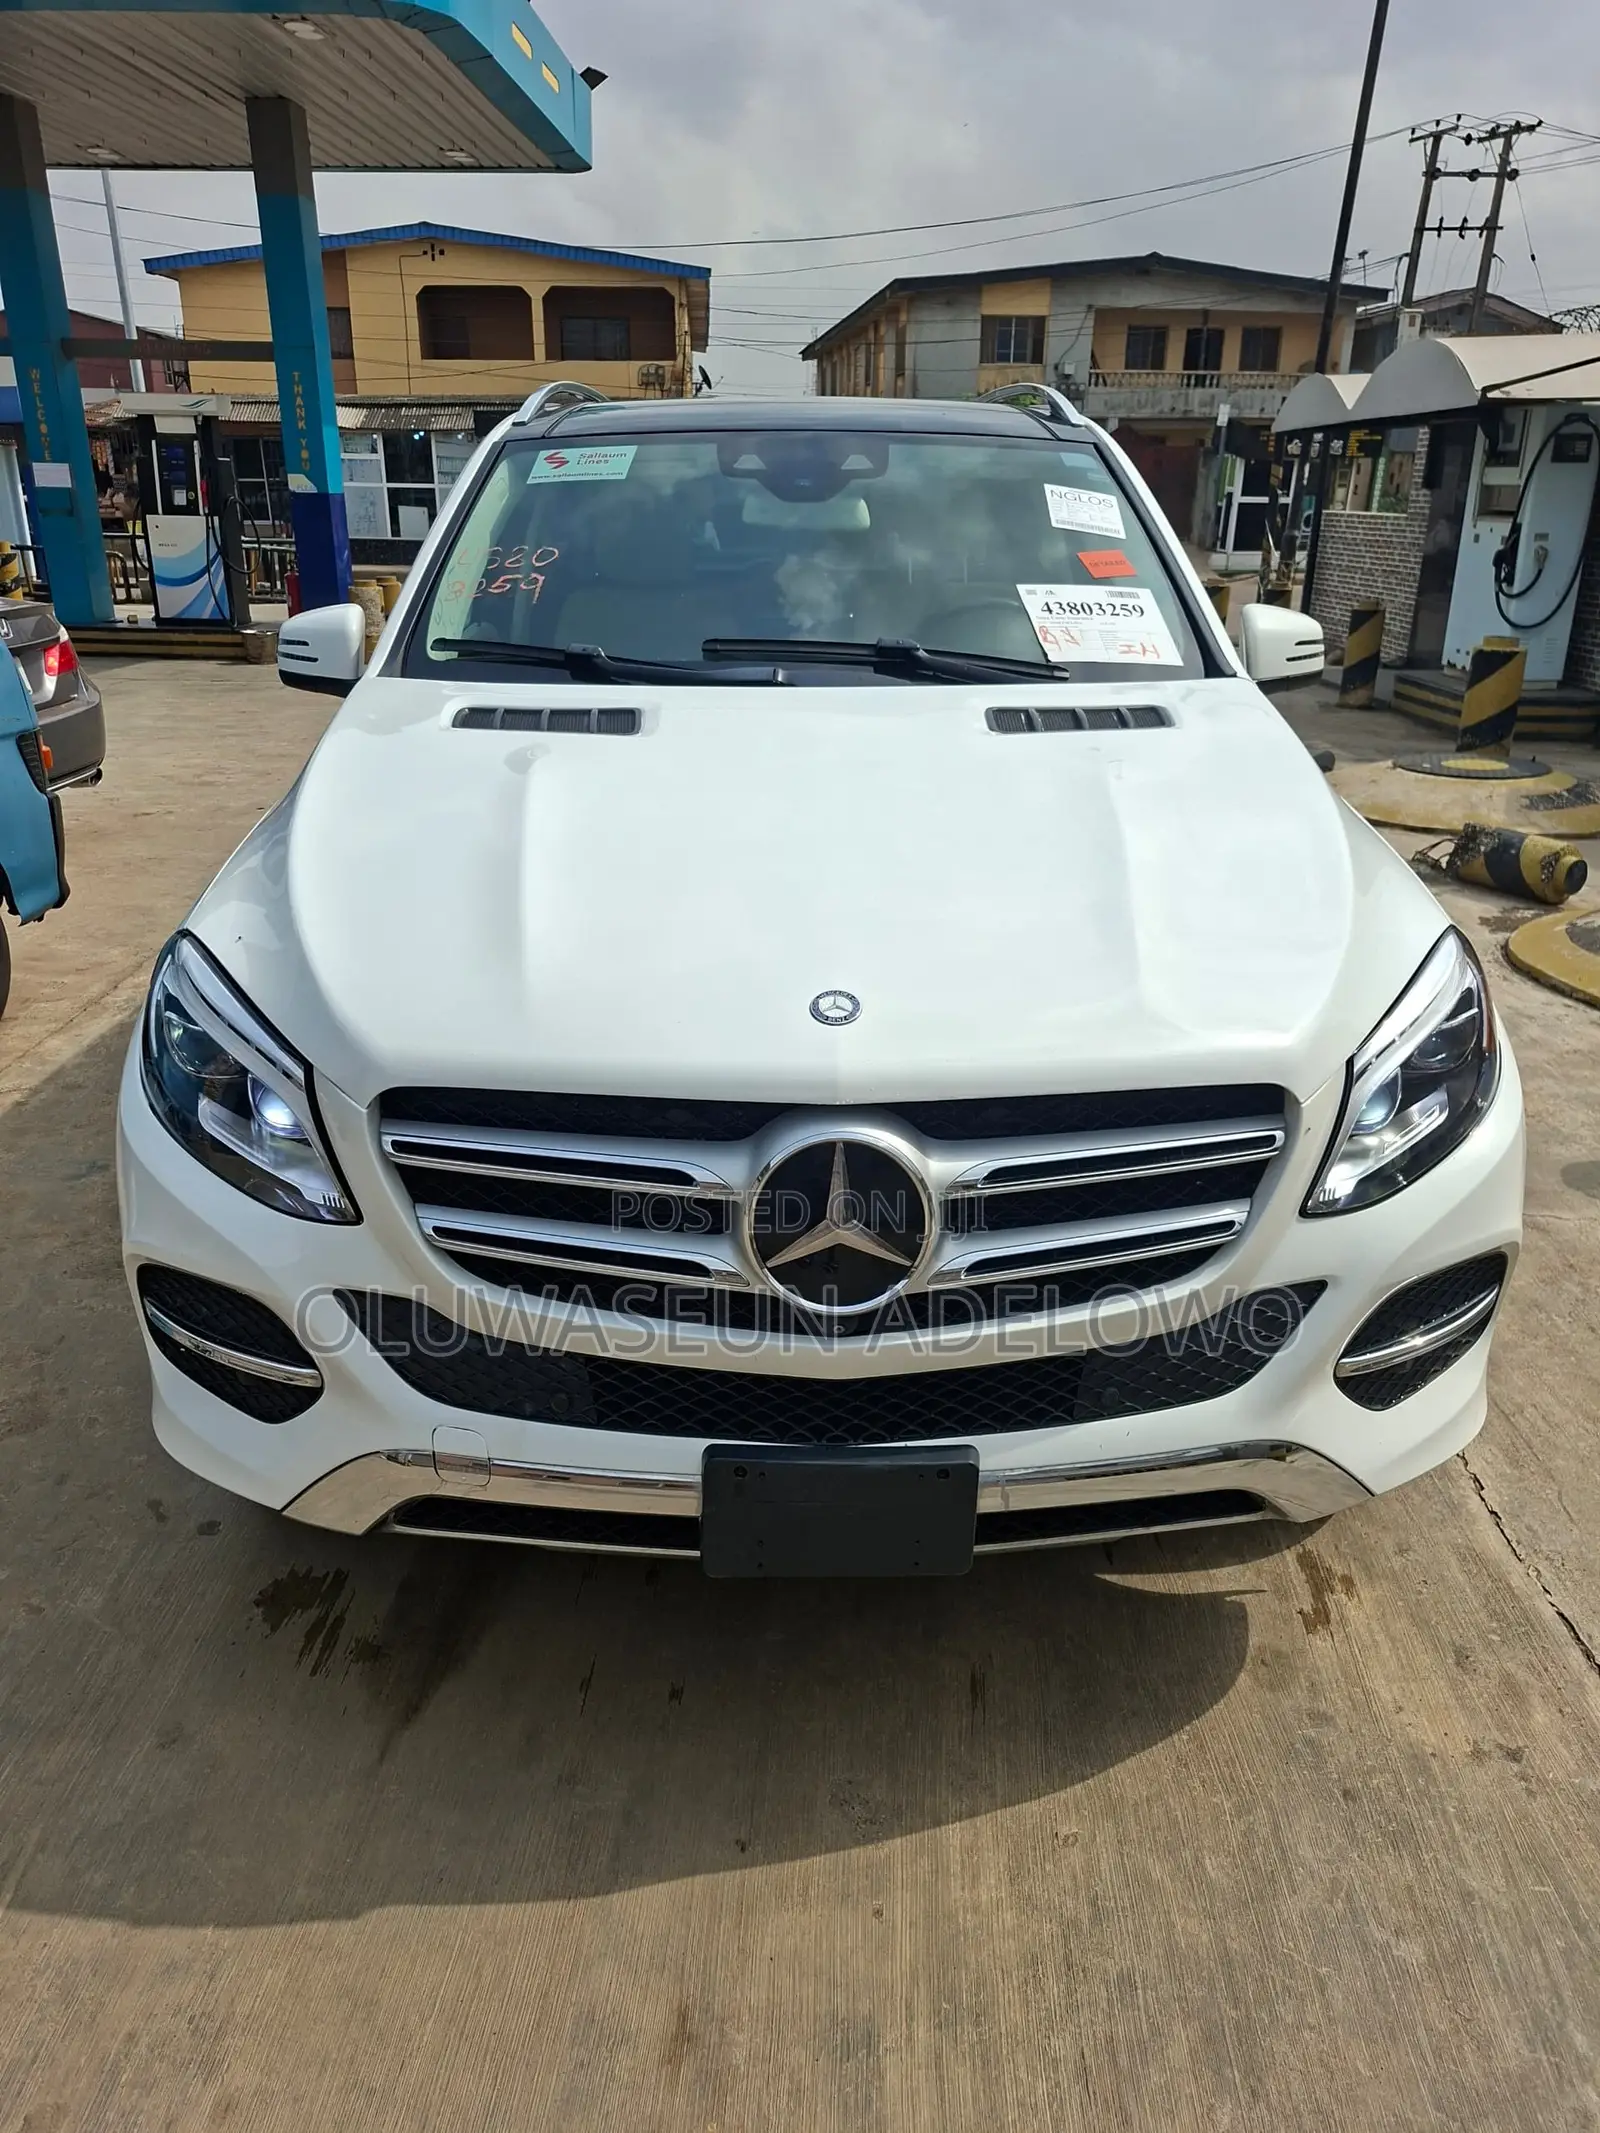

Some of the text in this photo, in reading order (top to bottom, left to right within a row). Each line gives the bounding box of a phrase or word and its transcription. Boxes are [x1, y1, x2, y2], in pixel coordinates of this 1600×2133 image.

[29, 367, 52, 460] WELCOME
[293, 371, 307, 430] THANK
[300, 437, 310, 470] YOU
[578, 452, 627, 460] Sallaum
[1050, 489, 1114, 508] NGLOS
[1041, 600, 1145, 618] 43803259
